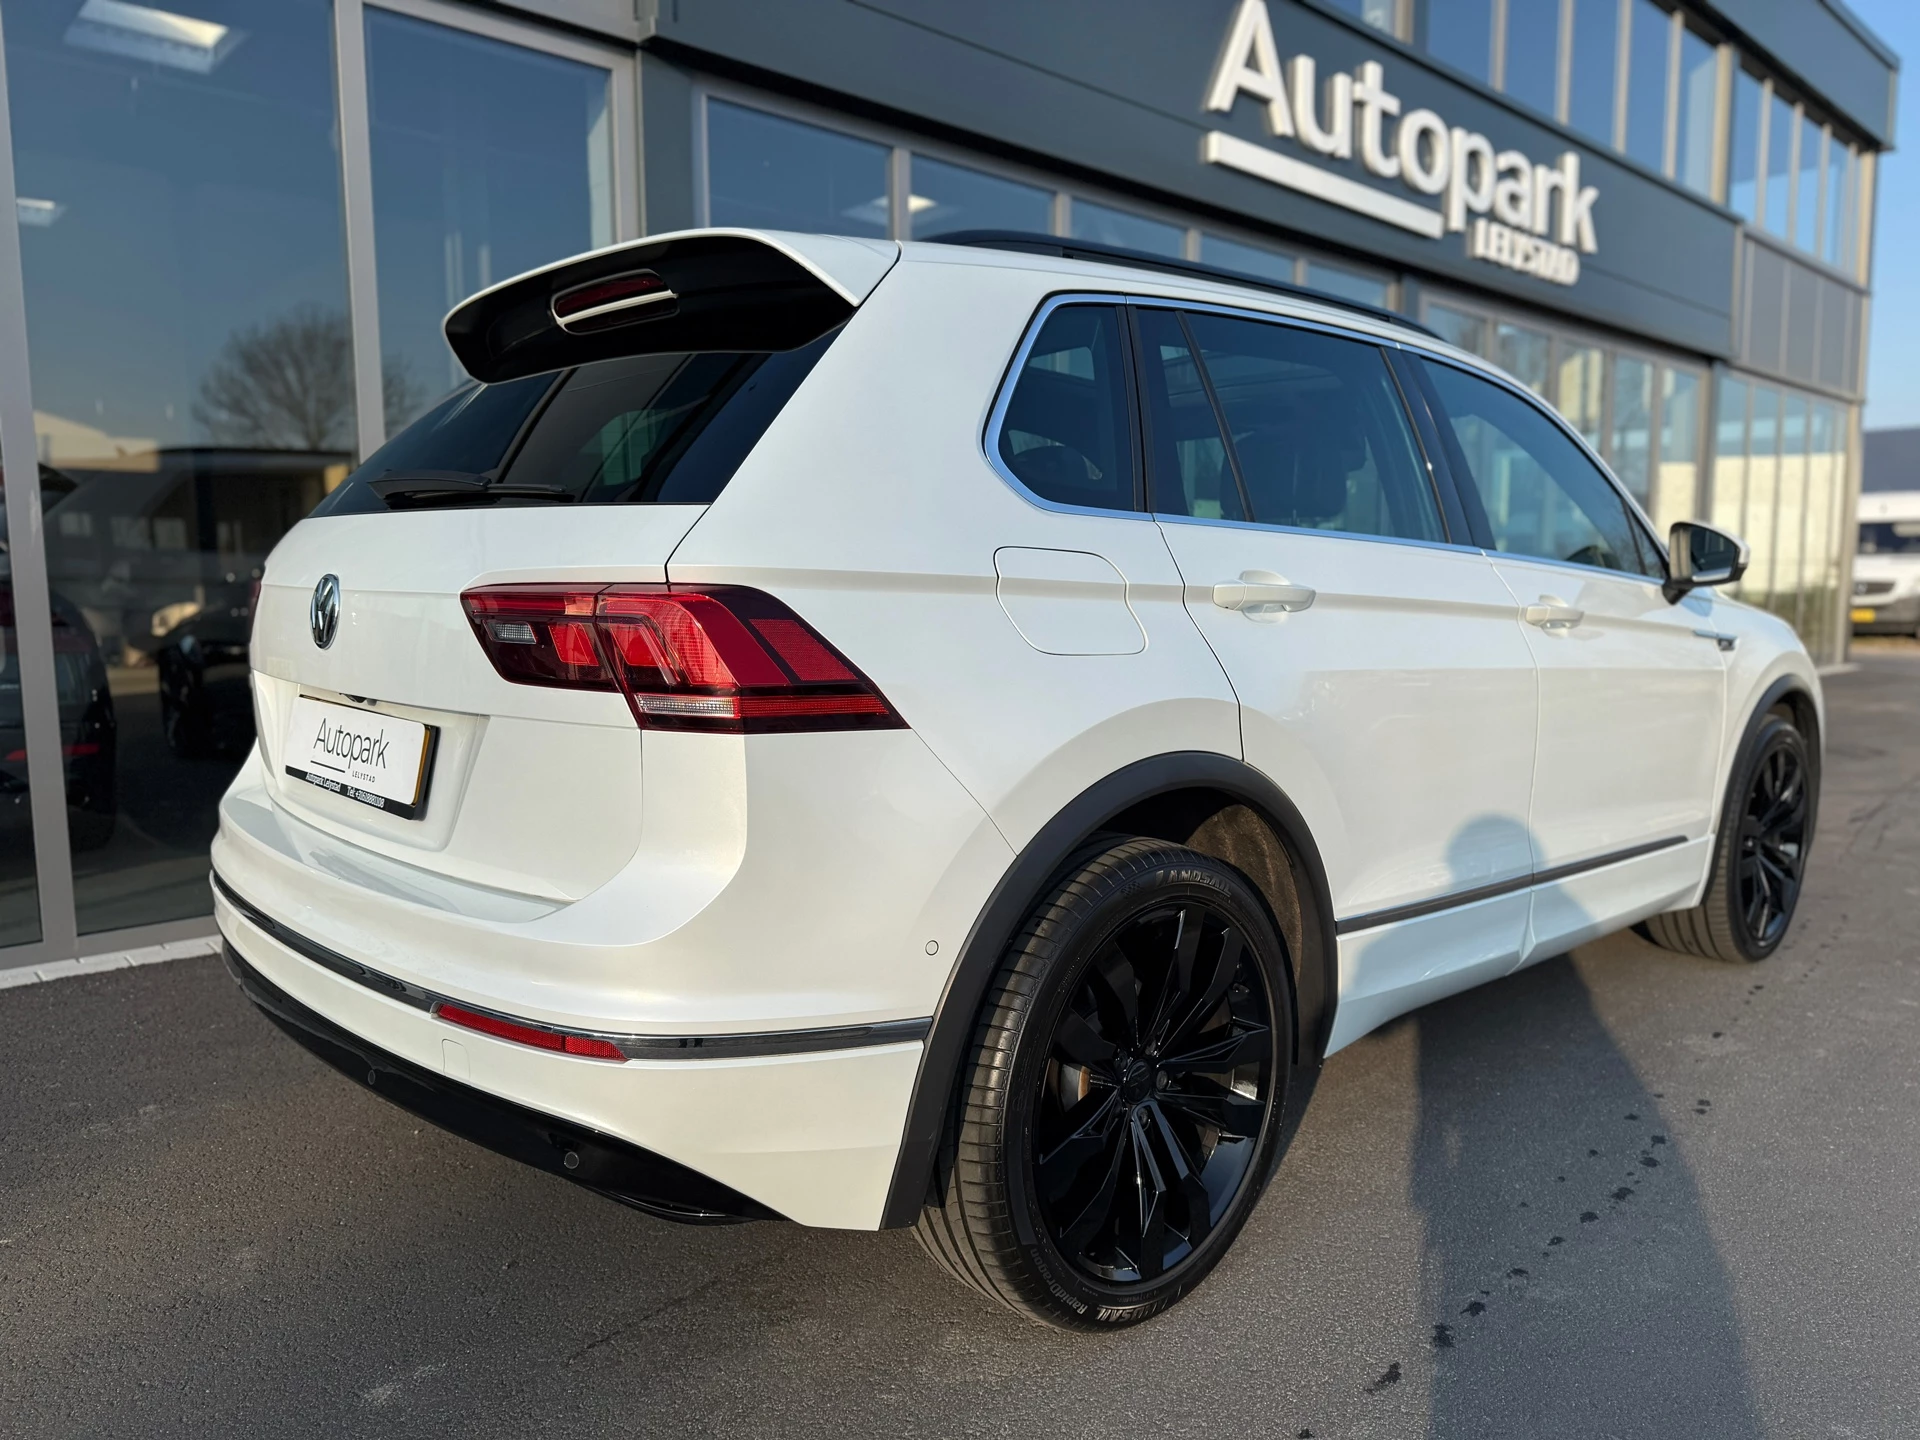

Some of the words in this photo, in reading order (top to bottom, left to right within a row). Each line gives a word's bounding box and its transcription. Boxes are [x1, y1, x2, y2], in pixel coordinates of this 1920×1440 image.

[1207, 0, 1599, 254] Autopark
[1472, 218, 1580, 286] LELYSTAD
[313, 717, 390, 769] Autopark
[352, 770, 376, 783] LELYSTAD
[1155, 869, 1232, 896] LANDSAIL
[1030, 1247, 1089, 1315] RapidDragon
